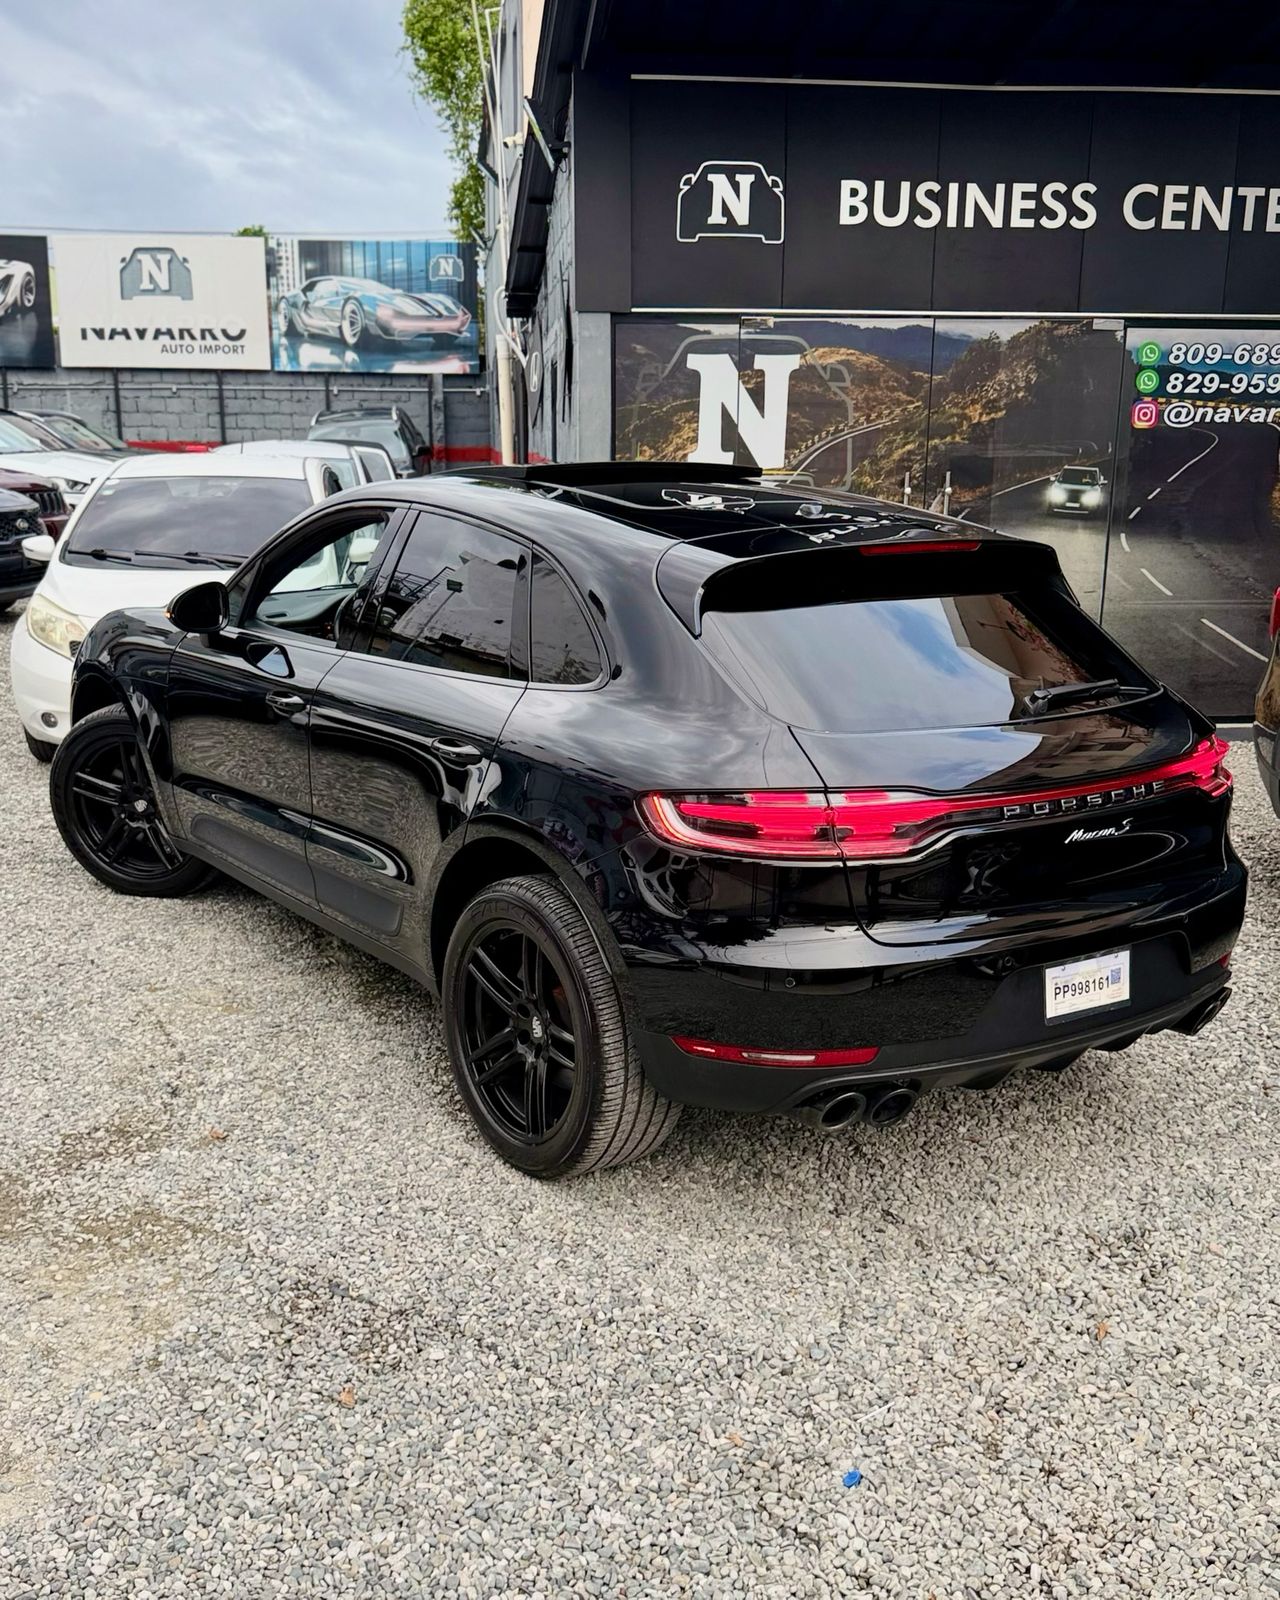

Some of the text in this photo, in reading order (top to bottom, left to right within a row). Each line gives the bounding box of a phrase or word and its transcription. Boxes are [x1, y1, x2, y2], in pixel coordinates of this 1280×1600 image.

[706, 173, 756, 226] N
[839, 179, 1098, 229] BUSINESS
[137, 253, 171, 290] N
[438, 257, 454, 276] N
[160, 344, 246, 355] AUTO IMPORT
[1167, 342, 1280, 365] 809-689
[1165, 372, 1280, 394] 829-959
[686, 353, 801, 468] N
[1003, 780, 1166, 818] PORSCHE
[1054, 975, 1110, 1001] PP998161
